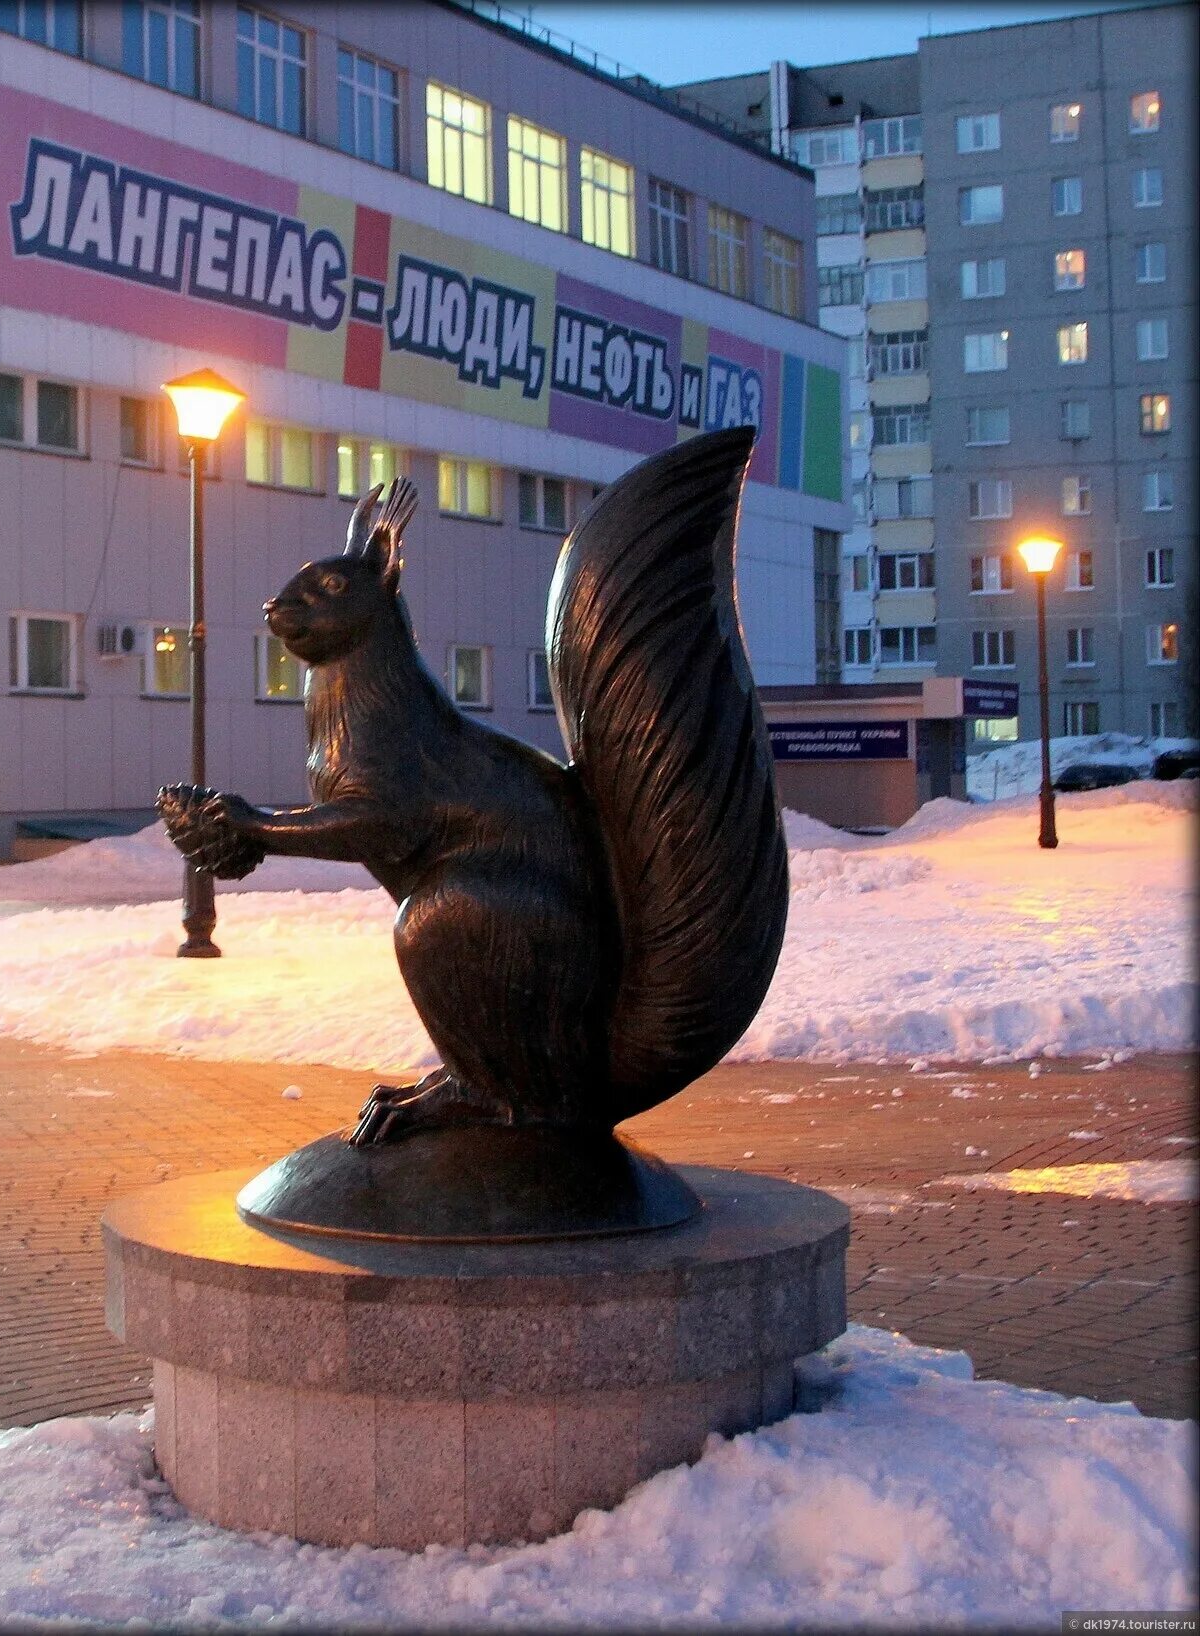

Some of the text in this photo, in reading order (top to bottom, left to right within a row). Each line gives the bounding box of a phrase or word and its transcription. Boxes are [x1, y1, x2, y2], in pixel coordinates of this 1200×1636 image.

[17, 149, 343, 322] ЛАНГЕПАС
[392, 265, 542, 390] ЛЮДИ,
[554, 313, 675, 412] НЕФТЬ
[681, 373, 700, 420] и
[707, 364, 761, 430] ГАЗ
